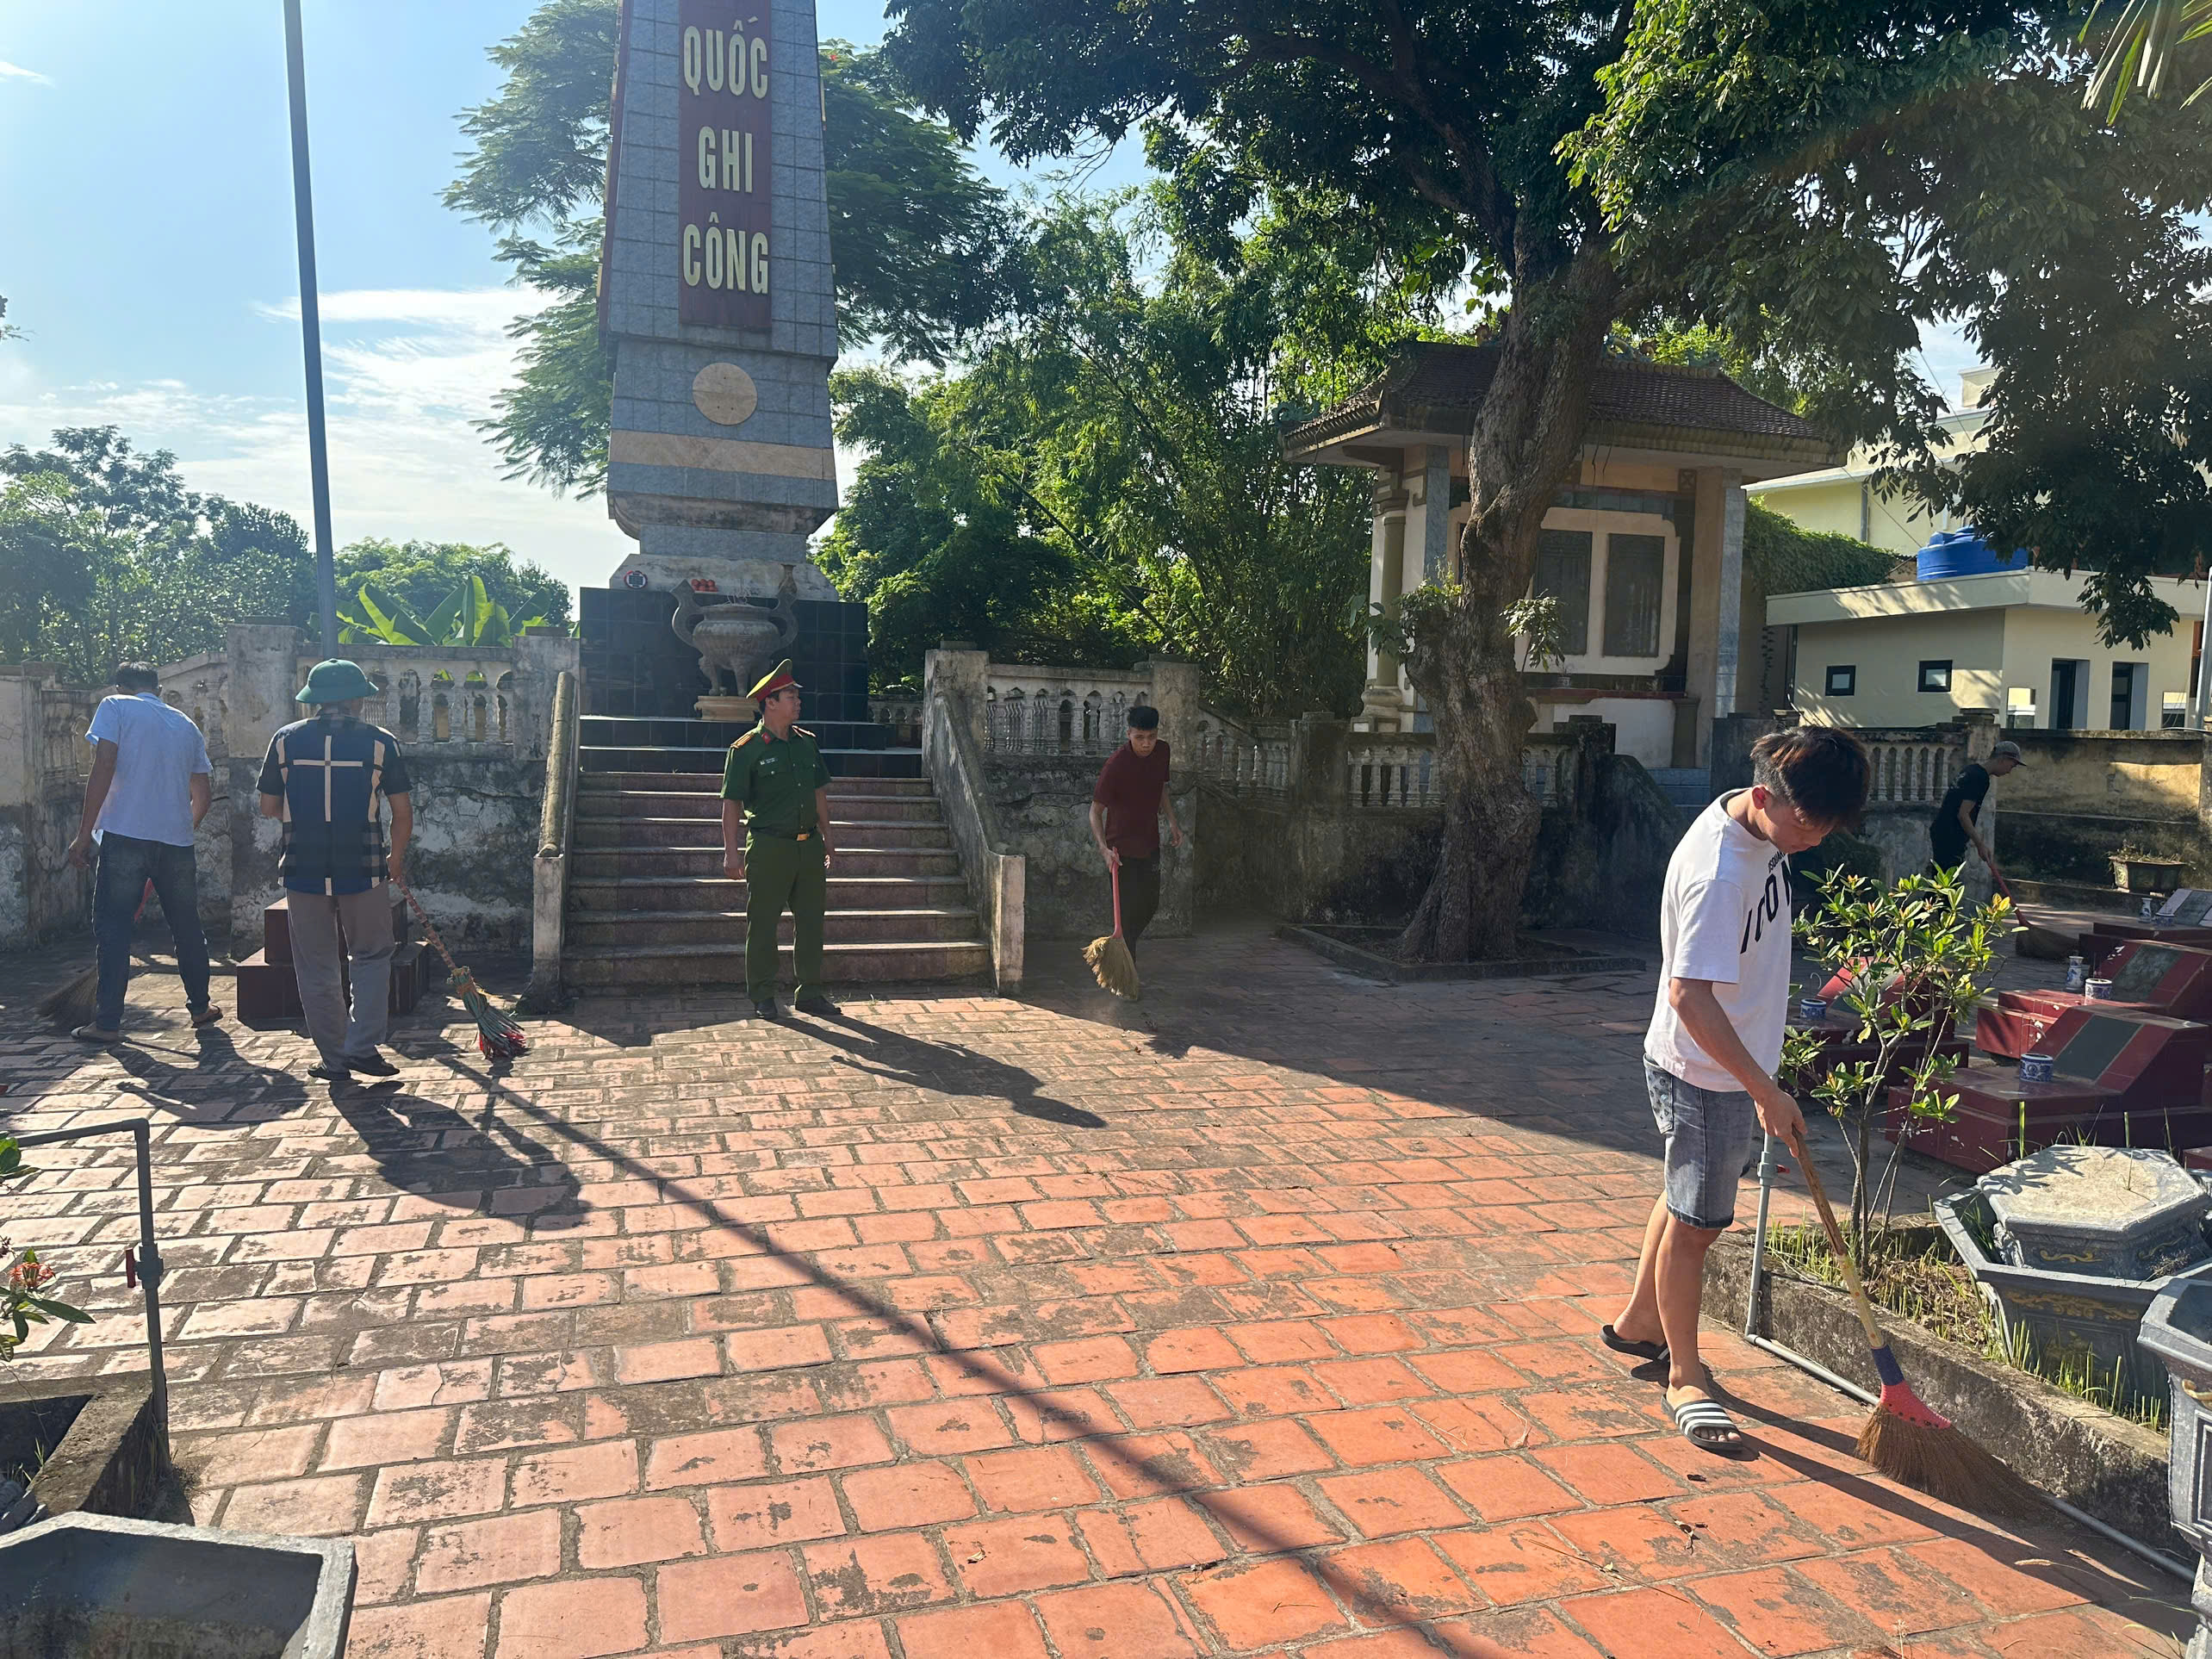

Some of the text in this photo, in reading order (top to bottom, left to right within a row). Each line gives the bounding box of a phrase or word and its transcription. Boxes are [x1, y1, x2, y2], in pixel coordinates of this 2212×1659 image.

[683, 16, 768, 100] QUỐC
[698, 126, 753, 194] GHI
[682, 211, 768, 295] CÔNG
